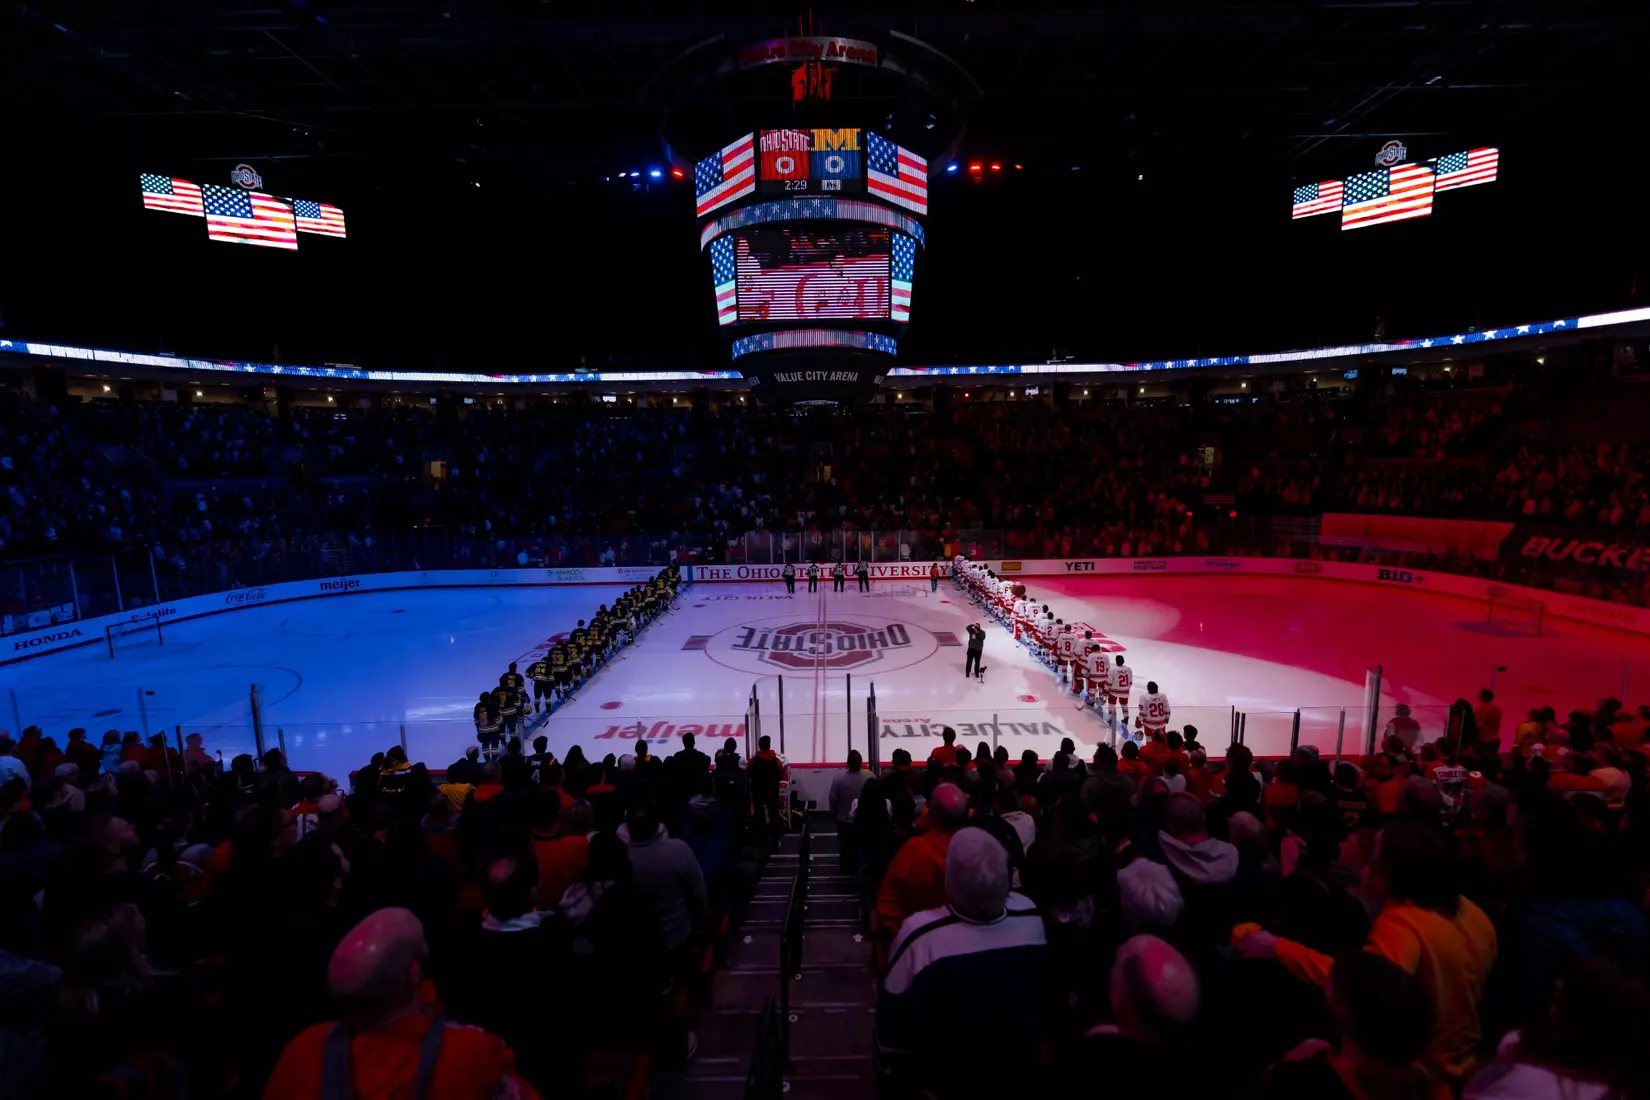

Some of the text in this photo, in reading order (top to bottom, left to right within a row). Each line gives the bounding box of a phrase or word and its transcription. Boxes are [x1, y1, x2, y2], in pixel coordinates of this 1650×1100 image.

[811, 128, 861, 151] M
[784, 180, 807, 191] 2:29
[773, 371, 803, 383] VALUE
[805, 370, 828, 381] CITY
[829, 371, 859, 382] ARENA
[697, 566, 732, 579] THE
[737, 565, 781, 579] OHIO
[1065, 561, 1095, 571] YETI
[319, 577, 361, 591] meijer
[13, 628, 84, 651] HONDA
[1064, 641, 1071, 652] 8
[1095, 660, 1105, 673] 19
[1118, 673, 1129, 688] 21
[594, 720, 746, 745] meijer
[957, 721, 1066, 737] VALUE
